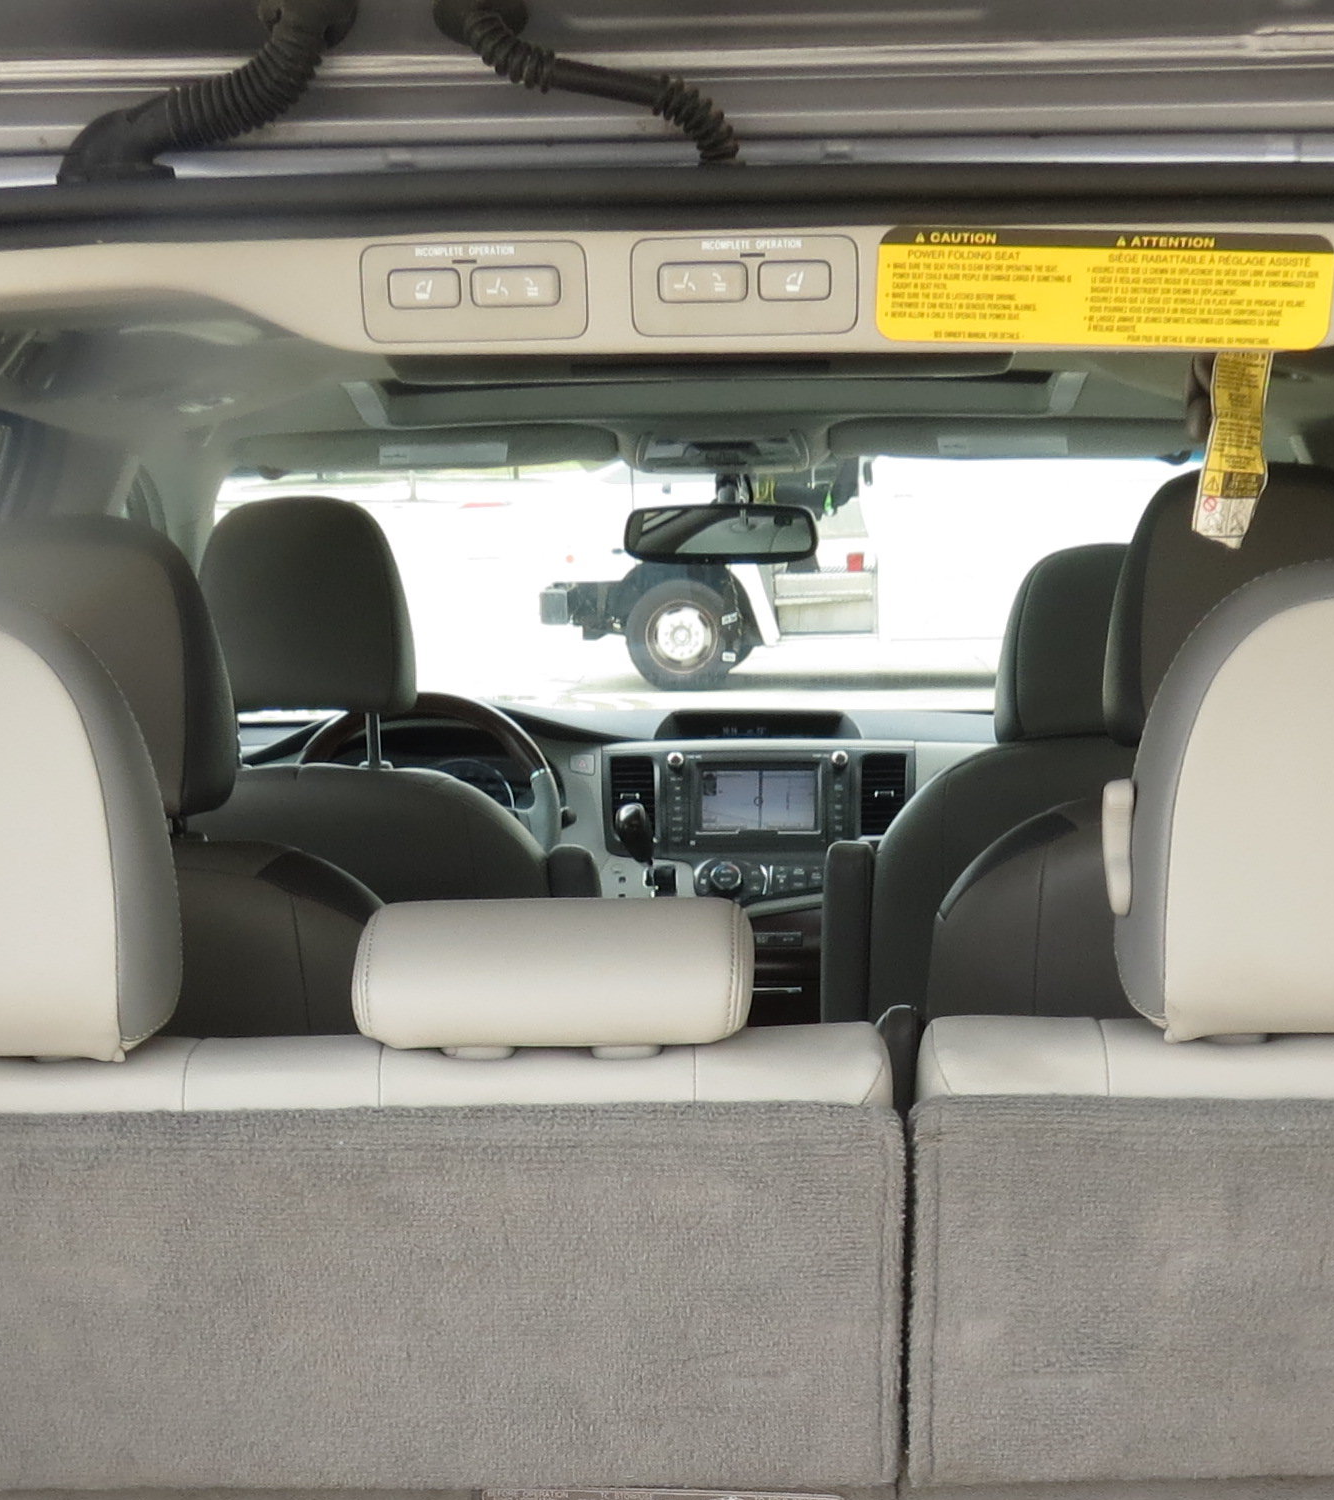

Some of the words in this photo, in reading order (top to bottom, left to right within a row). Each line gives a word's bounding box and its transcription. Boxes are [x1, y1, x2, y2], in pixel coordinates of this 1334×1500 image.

[930, 231, 996, 244] CAUTION
[1131, 235, 1215, 248] ATTENTION
[701, 240, 750, 250] INCOMPLETE
[755, 239, 802, 250] OPERATION
[415, 247, 463, 257] INCOMPLETE
[468, 245, 515, 256] OPERATION
[907, 249, 945, 260] POWER
[948, 250, 992, 260] FOLDING
[994, 251, 1021, 261] SEAT
